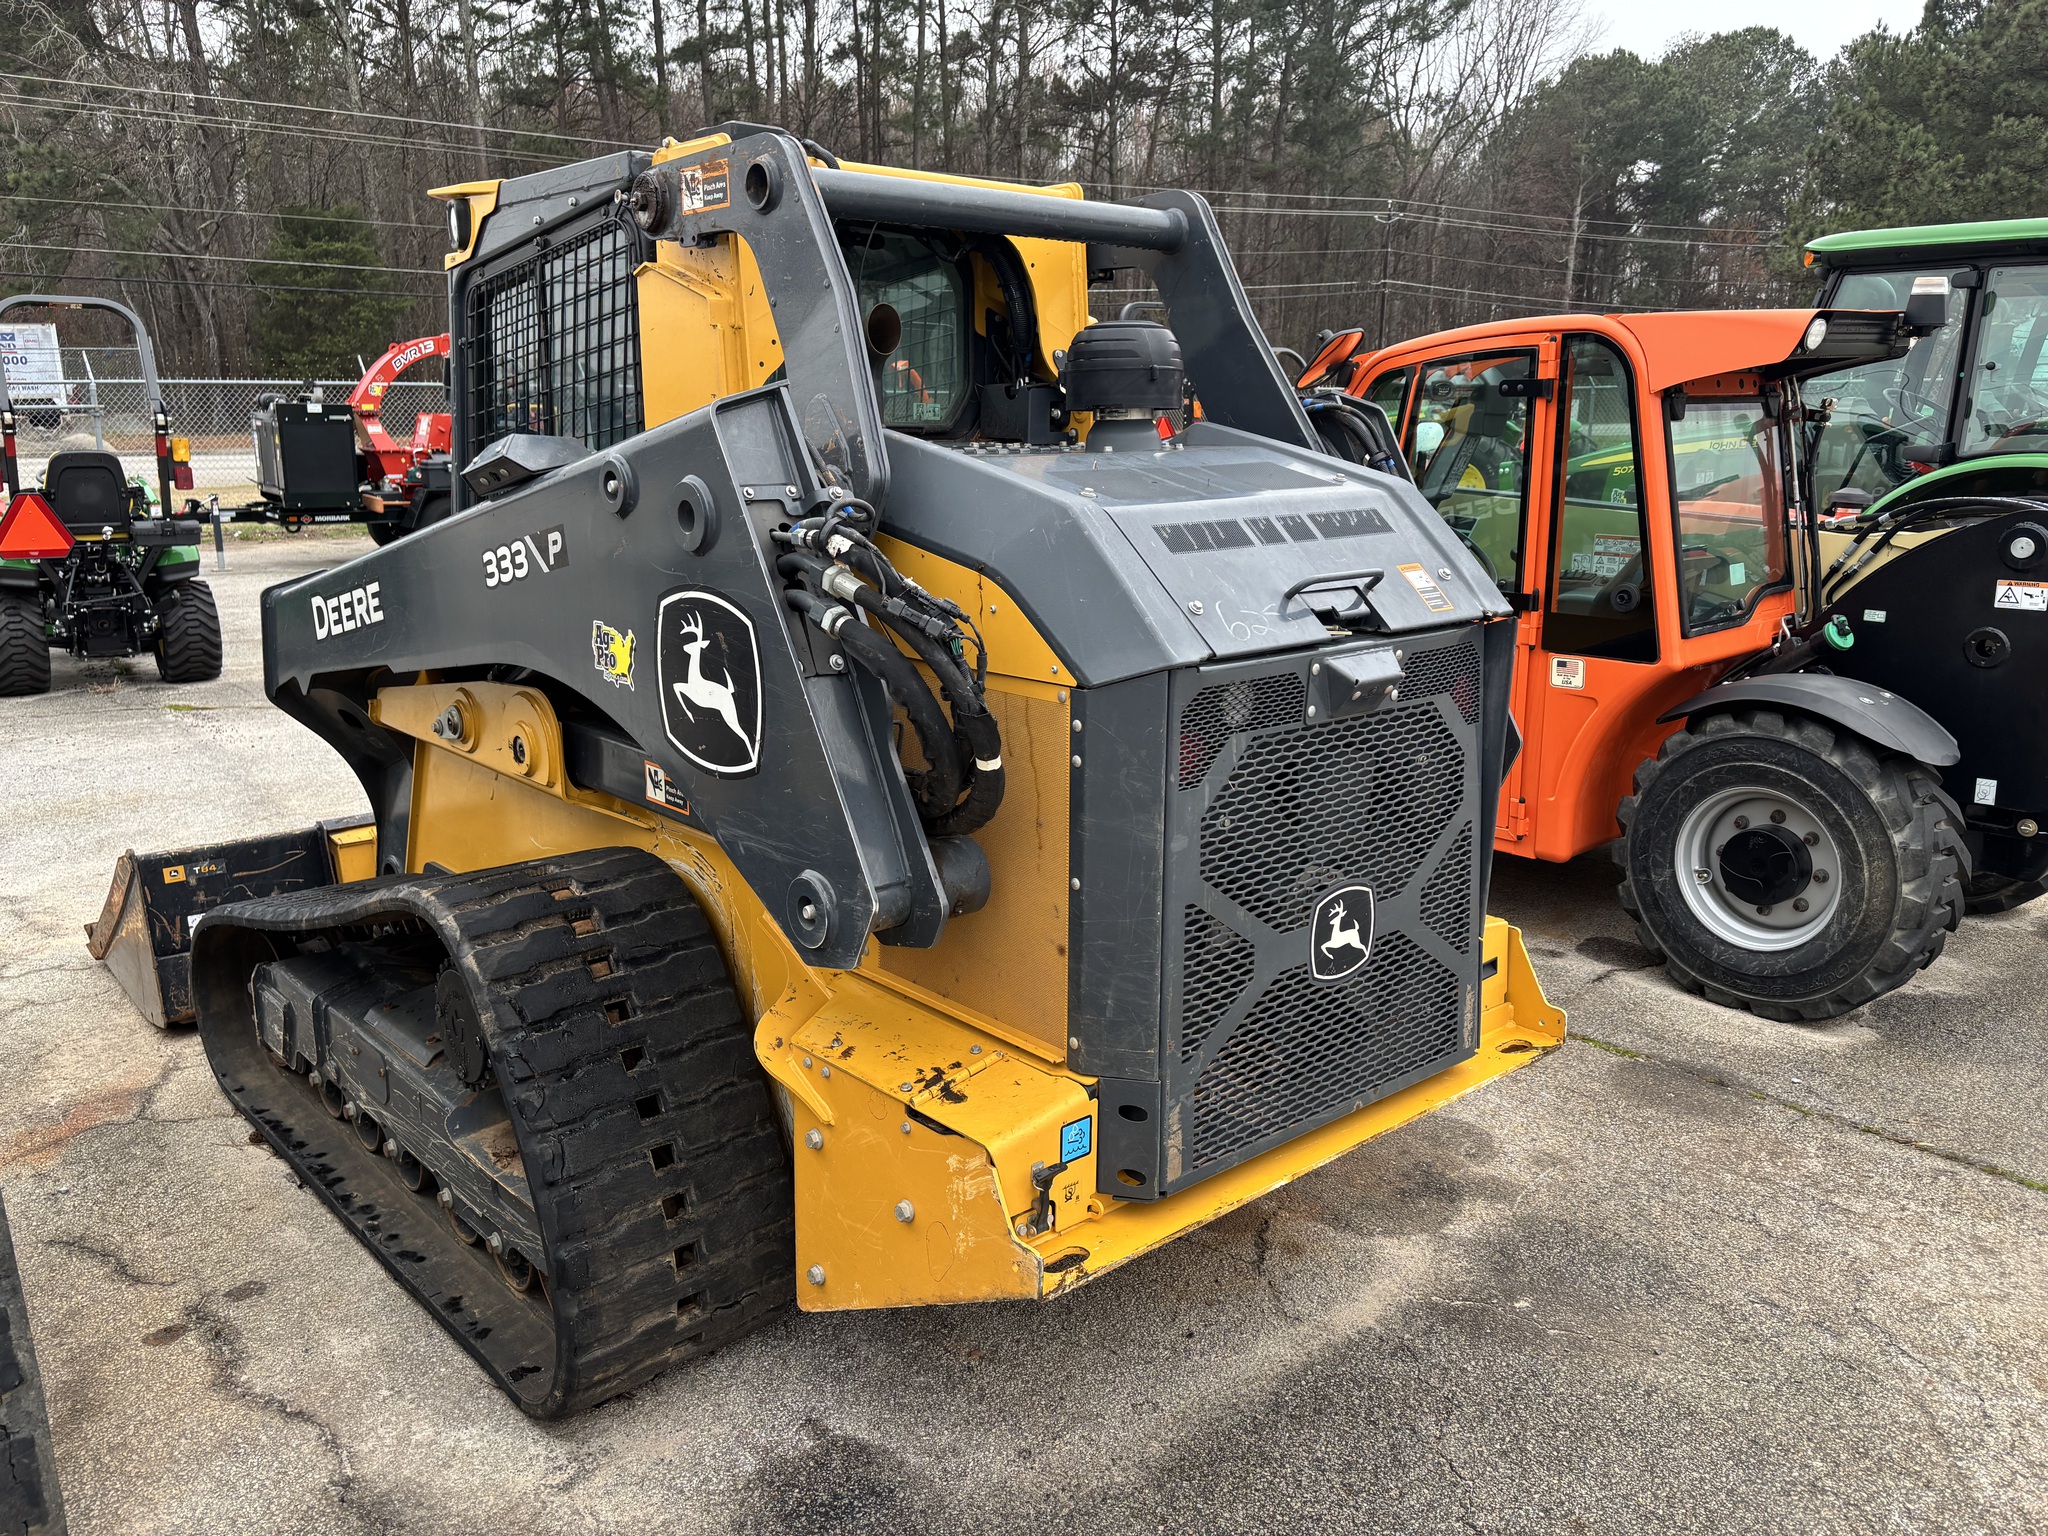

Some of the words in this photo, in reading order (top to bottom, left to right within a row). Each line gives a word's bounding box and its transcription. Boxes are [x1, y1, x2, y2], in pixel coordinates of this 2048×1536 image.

[419, 340, 434, 355] 13
[2, 356, 28, 365] 000
[1612, 465, 1635, 477] 507
[311, 581, 385, 640] DEERE
[596, 645, 617, 669] Pro
